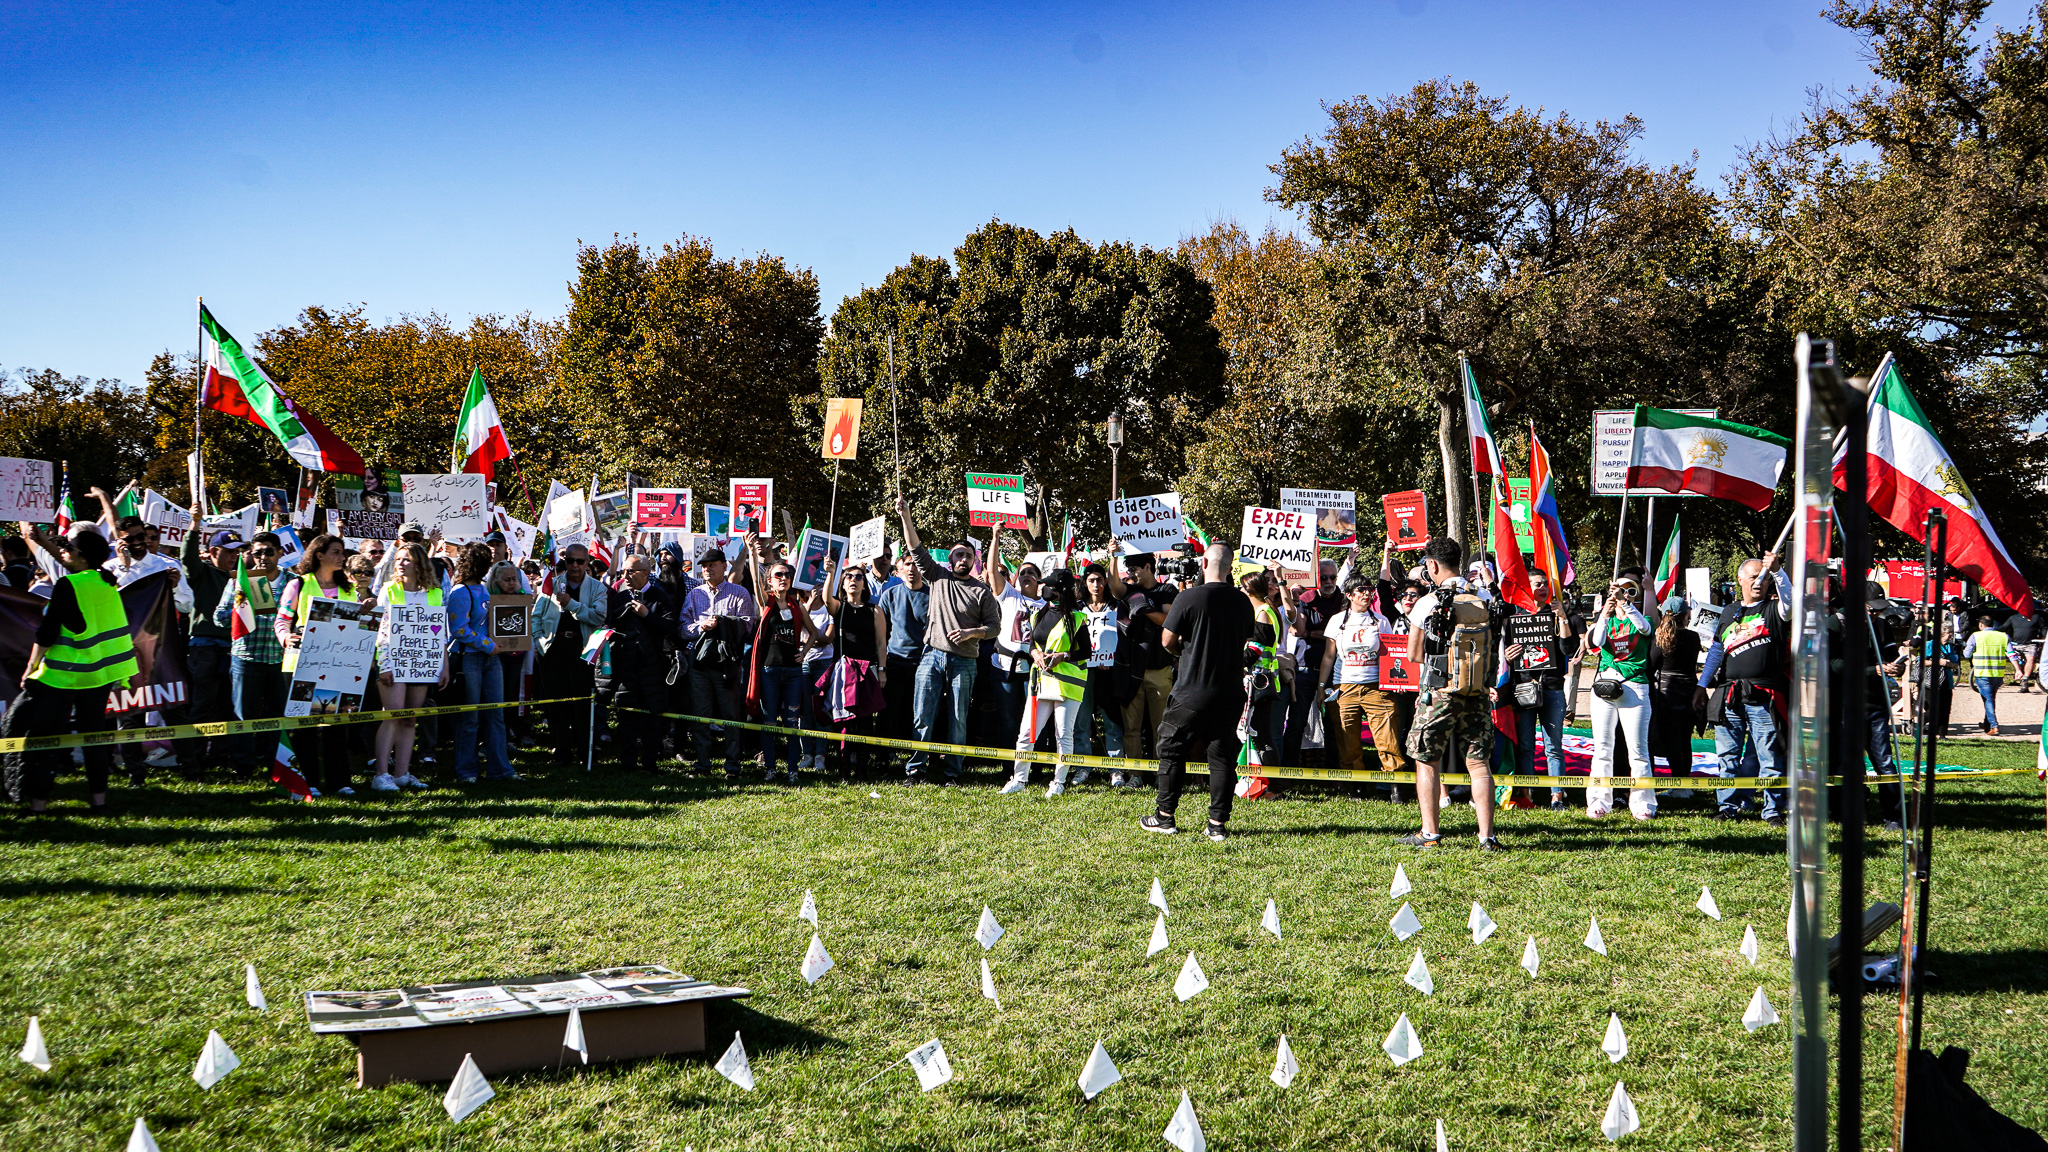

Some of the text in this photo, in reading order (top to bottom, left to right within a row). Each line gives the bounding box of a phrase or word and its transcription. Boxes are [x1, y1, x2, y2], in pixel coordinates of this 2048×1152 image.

[26, 460, 44, 476] SAY
[23, 476, 47, 493] HER
[972, 475, 1017, 489] WOMAN
[344, 492, 359, 504] AM
[645, 493, 664, 502] Stop
[982, 491, 1010, 504] LIFE
[1295, 491, 1331, 499] TREATMENT
[1114, 498, 1161, 514] Biden
[348, 511, 361, 520] AM
[362, 511, 385, 521] EVERY
[386, 513, 402, 524] GIRL
[974, 511, 1025, 525] FREEDOM
[1145, 507, 1177, 523] Deal
[1251, 508, 1306, 529] EXPEL
[1114, 528, 1178, 542] with Mullas
[1256, 526, 1302, 540] IRAN
[1241, 544, 1313, 562] DIPLOMATS
[393, 606, 444, 624] THE POWER
[391, 623, 429, 634] OF THE
[1515, 625, 1549, 634] ISLAMIC
[399, 635, 440, 649] PEOPLE IS
[1513, 635, 1553, 643] REPUBLIC
[391, 648, 443, 659] GREATER THAN
[1730, 637, 1772, 657] FREE IRAN
[392, 658, 439, 669] THE PEOPLE
[395, 669, 440, 678] IN POWER
[105, 681, 185, 714] AMINI
[196, 724, 226, 736] CAUTION
[252, 720, 280, 730] CUIDADO
